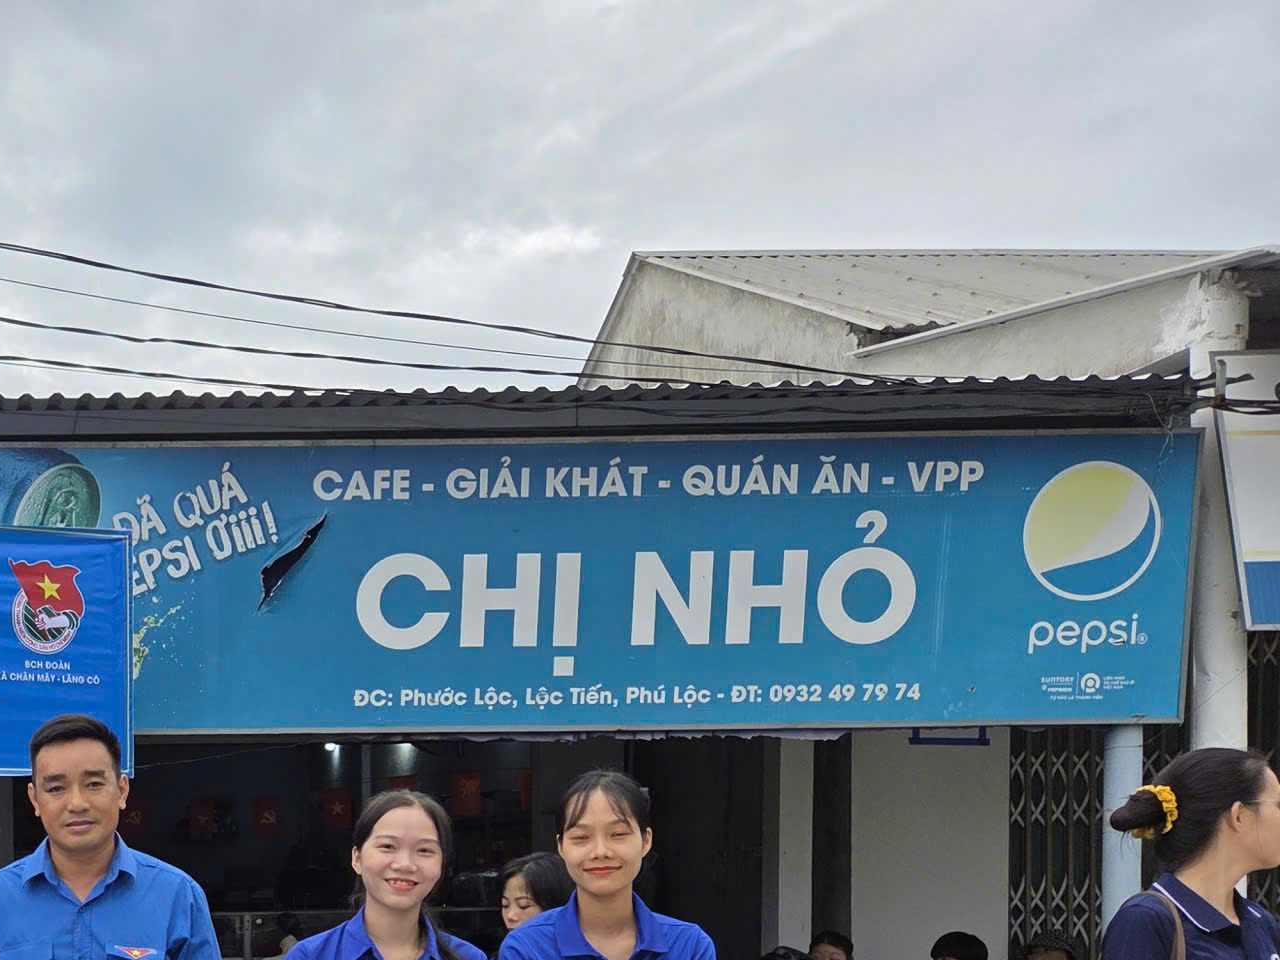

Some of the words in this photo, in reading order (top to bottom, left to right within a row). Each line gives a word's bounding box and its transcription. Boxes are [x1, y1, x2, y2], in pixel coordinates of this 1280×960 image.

[173, 462, 248, 528] QUÁ
[313, 469, 410, 501] CAFE
[446, 456, 530, 499] GIẢI
[546, 457, 648, 498] KHÁT
[682, 455, 798, 496] QUÁN
[812, 456, 870, 494] ĂN
[907, 460, 984, 492] VPP
[132, 536, 202, 596] EPSI
[356, 552, 582, 677] CHỊ
[631, 510, 916, 645] NHỎ
[1028, 614, 1138, 654] pepsi
[9, 671, 34, 682] CHÂN
[37, 672, 56, 682] MÂY
[62, 673, 84, 684] LĂNG
[86, 674, 100, 684] CÔ
[24, 660, 43, 668] BCH
[45, 660, 70, 670] ĐOÀN
[354, 689, 393, 706] ĐC:
[400, 686, 467, 706] Phước
[474, 687, 518, 709] Lộc,
[526, 687, 565, 710] Lộc
[570, 684, 618, 708] Tiến,
[626, 686, 666, 704] Phú
[674, 686, 712, 708] Lộc
[730, 686, 762, 703] ĐT:
[769, 684, 822, 702] 0932
[828, 684, 856, 702] 49
[862, 684, 888, 702] 79
[895, 684, 920, 700] 74
